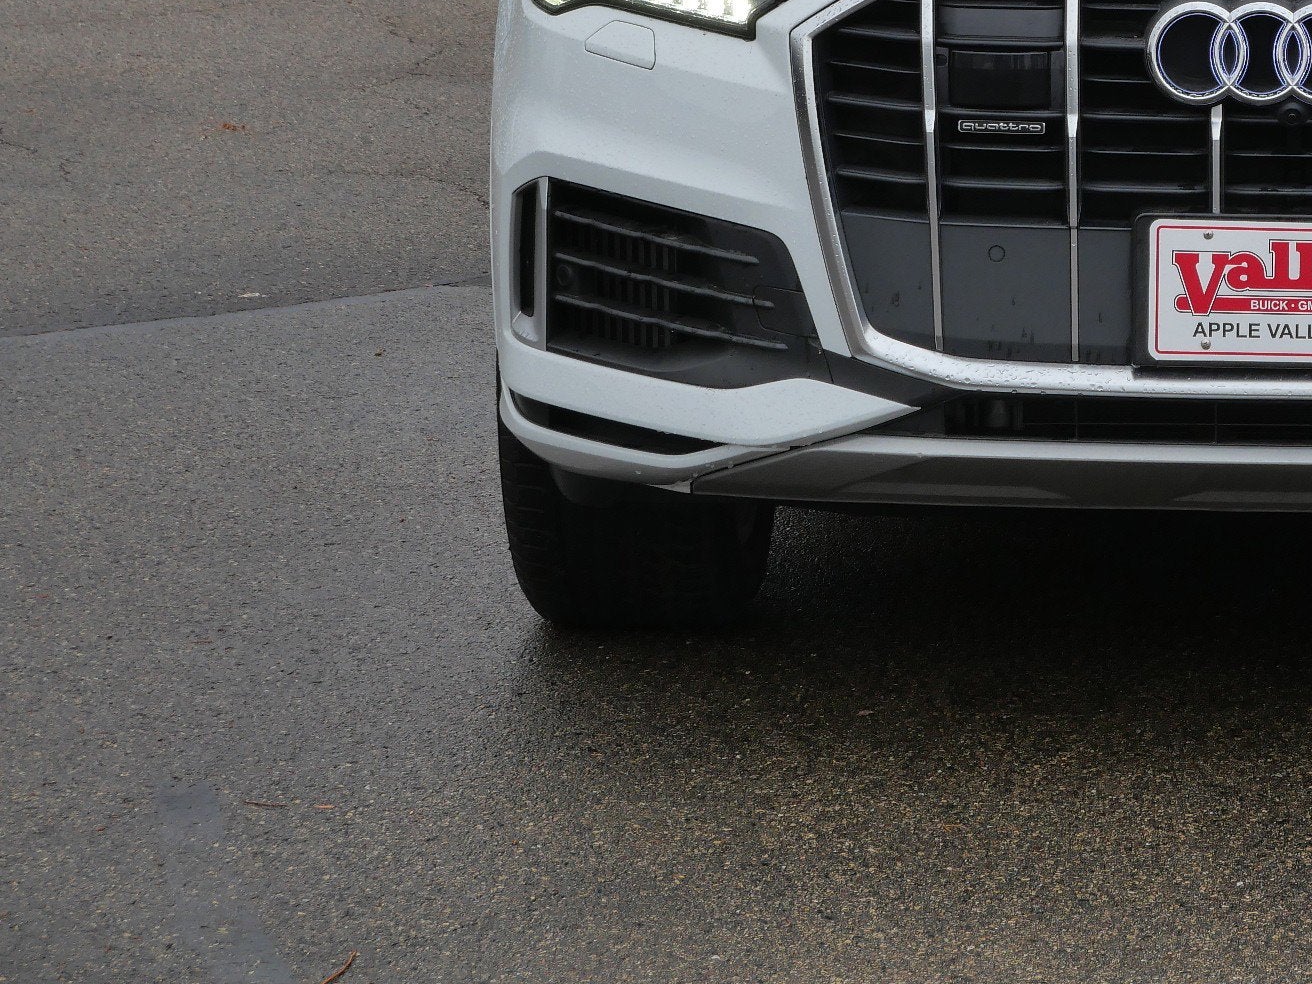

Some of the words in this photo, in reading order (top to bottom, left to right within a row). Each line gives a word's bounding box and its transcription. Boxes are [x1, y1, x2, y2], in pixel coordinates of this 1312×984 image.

[962, 122, 1042, 132] quattro
[1250, 300, 1288, 311] BUICK
[1193, 322, 1260, 339] APPLE
